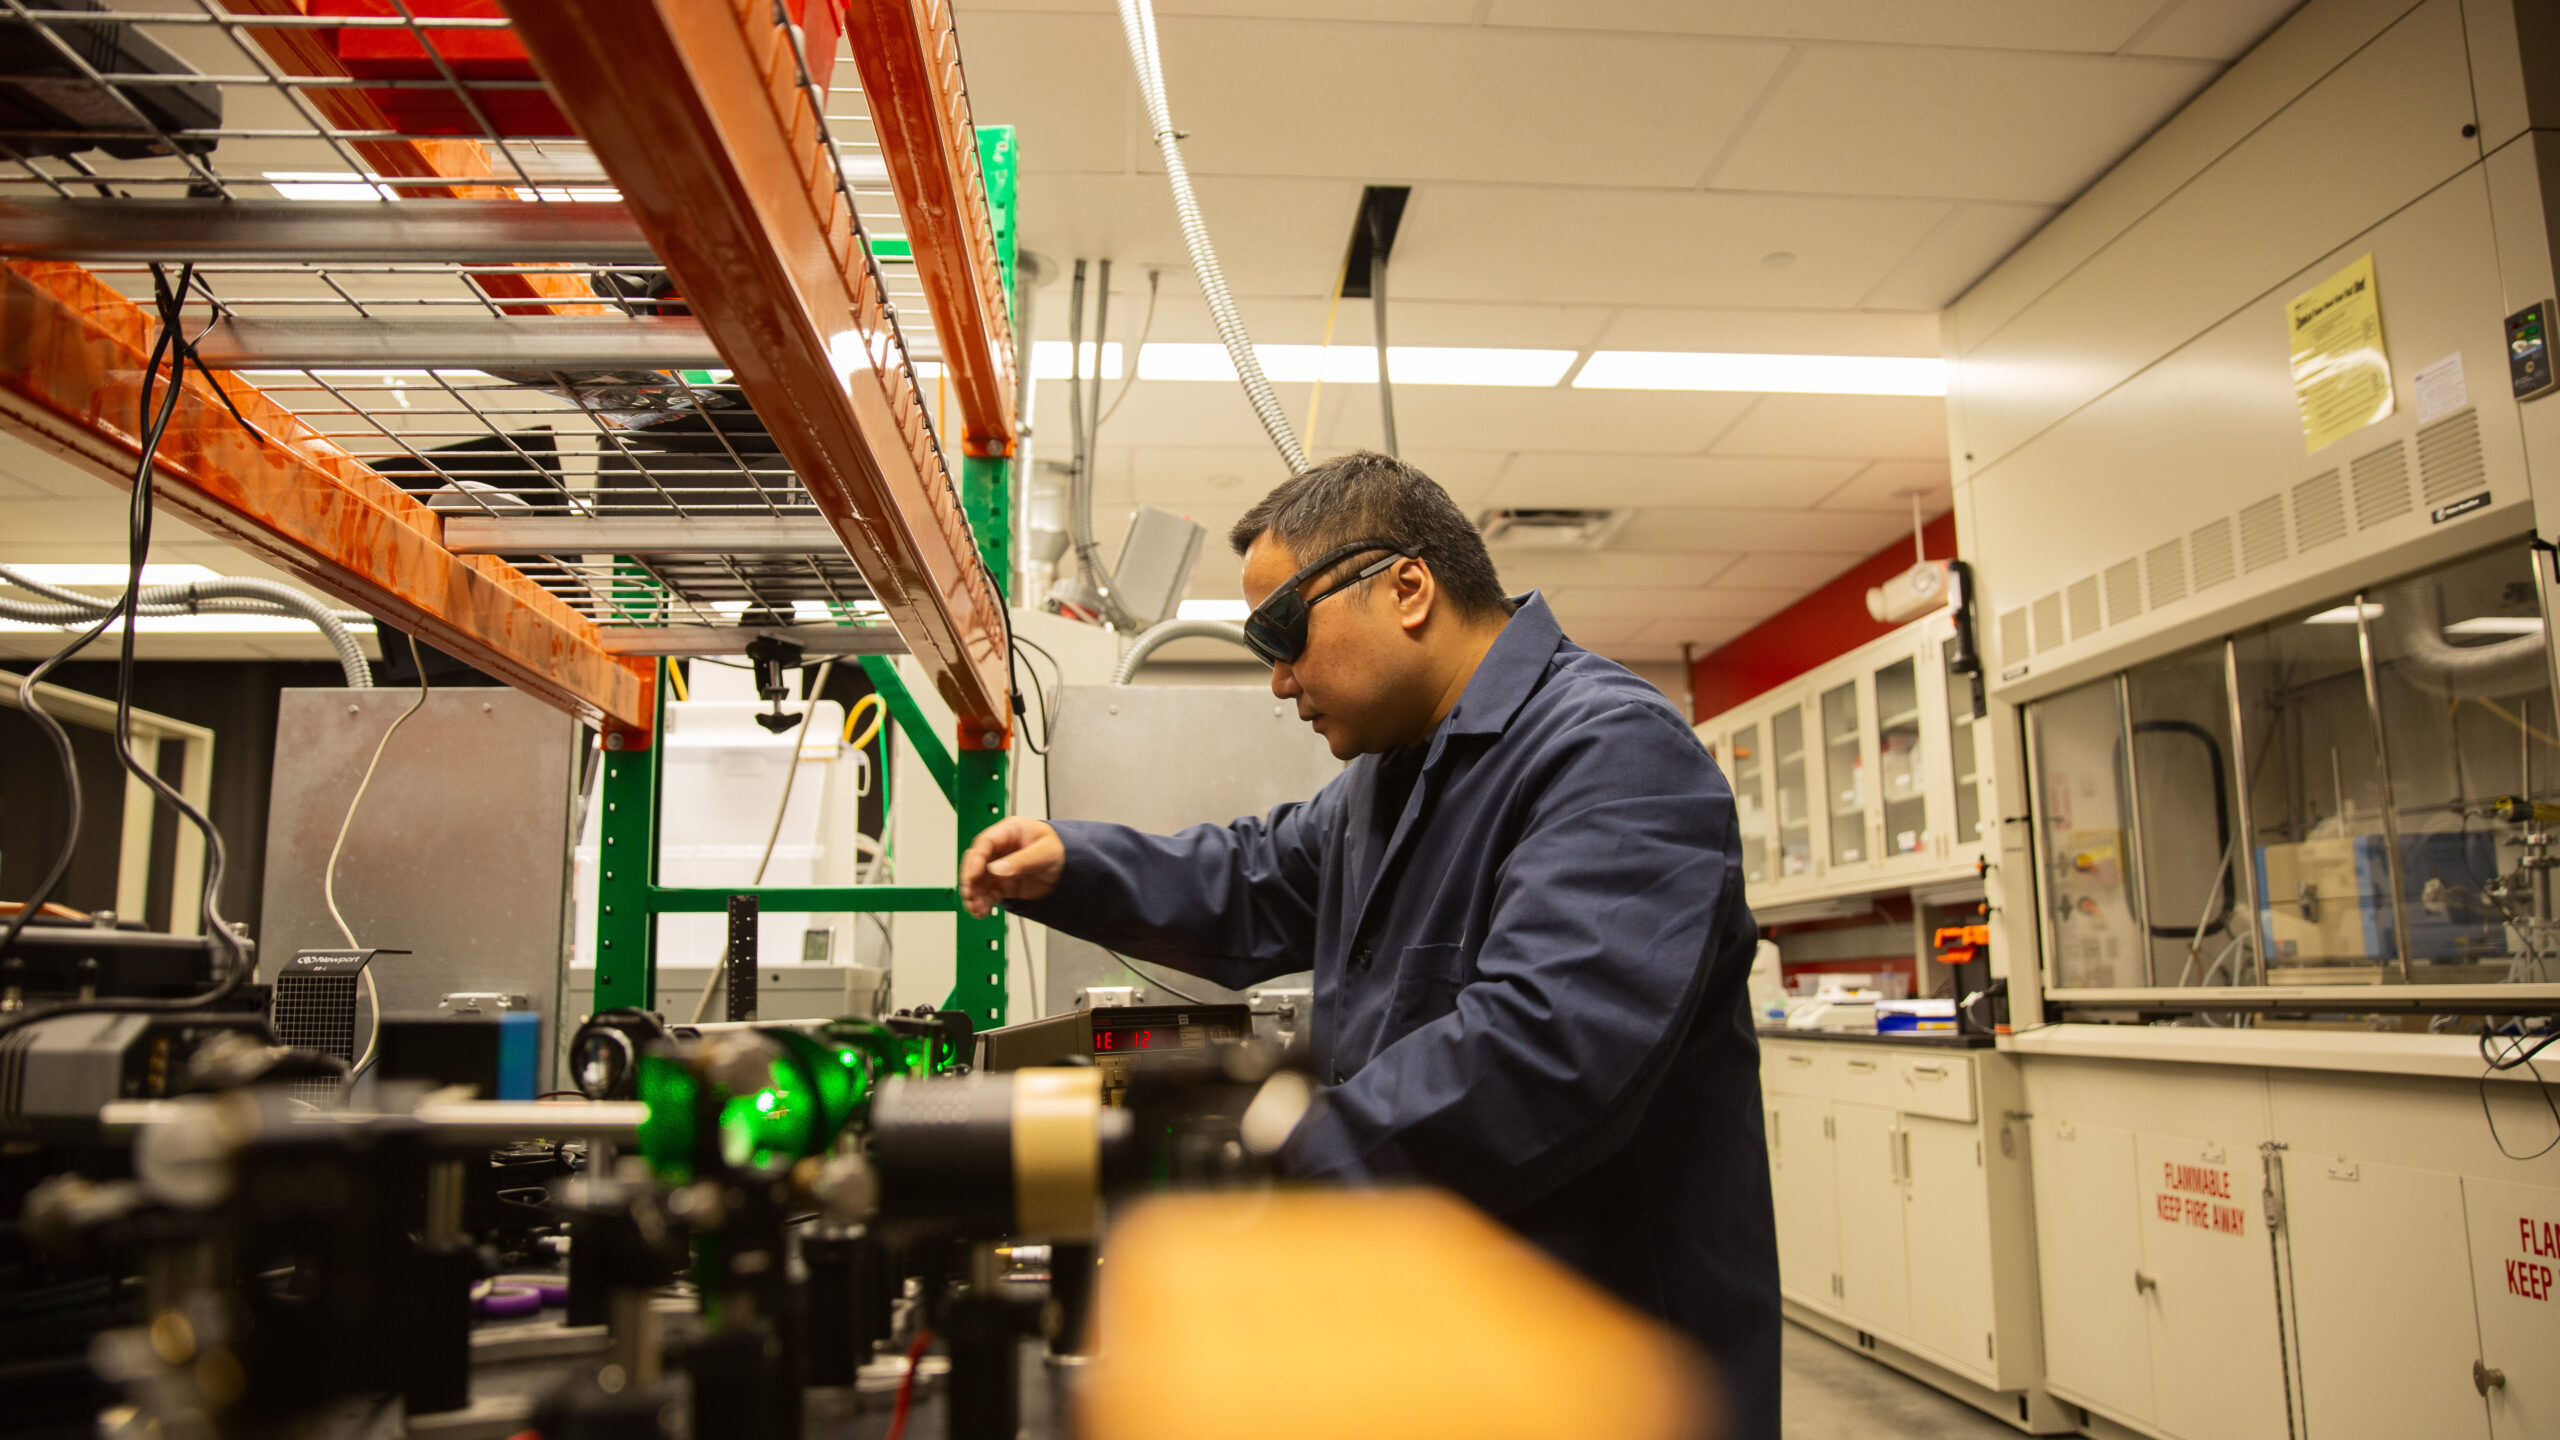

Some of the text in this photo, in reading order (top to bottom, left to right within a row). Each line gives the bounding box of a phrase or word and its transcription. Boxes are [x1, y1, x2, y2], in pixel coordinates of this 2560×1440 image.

[316, 956, 360, 964] Newport
[1135, 1030, 1151, 1048] 12
[2164, 1162, 2231, 1199] FLAMMABLE
[2157, 1193, 2245, 1237] KEEP FIRE AWAY
[2506, 1259, 2553, 1302] KEEP
